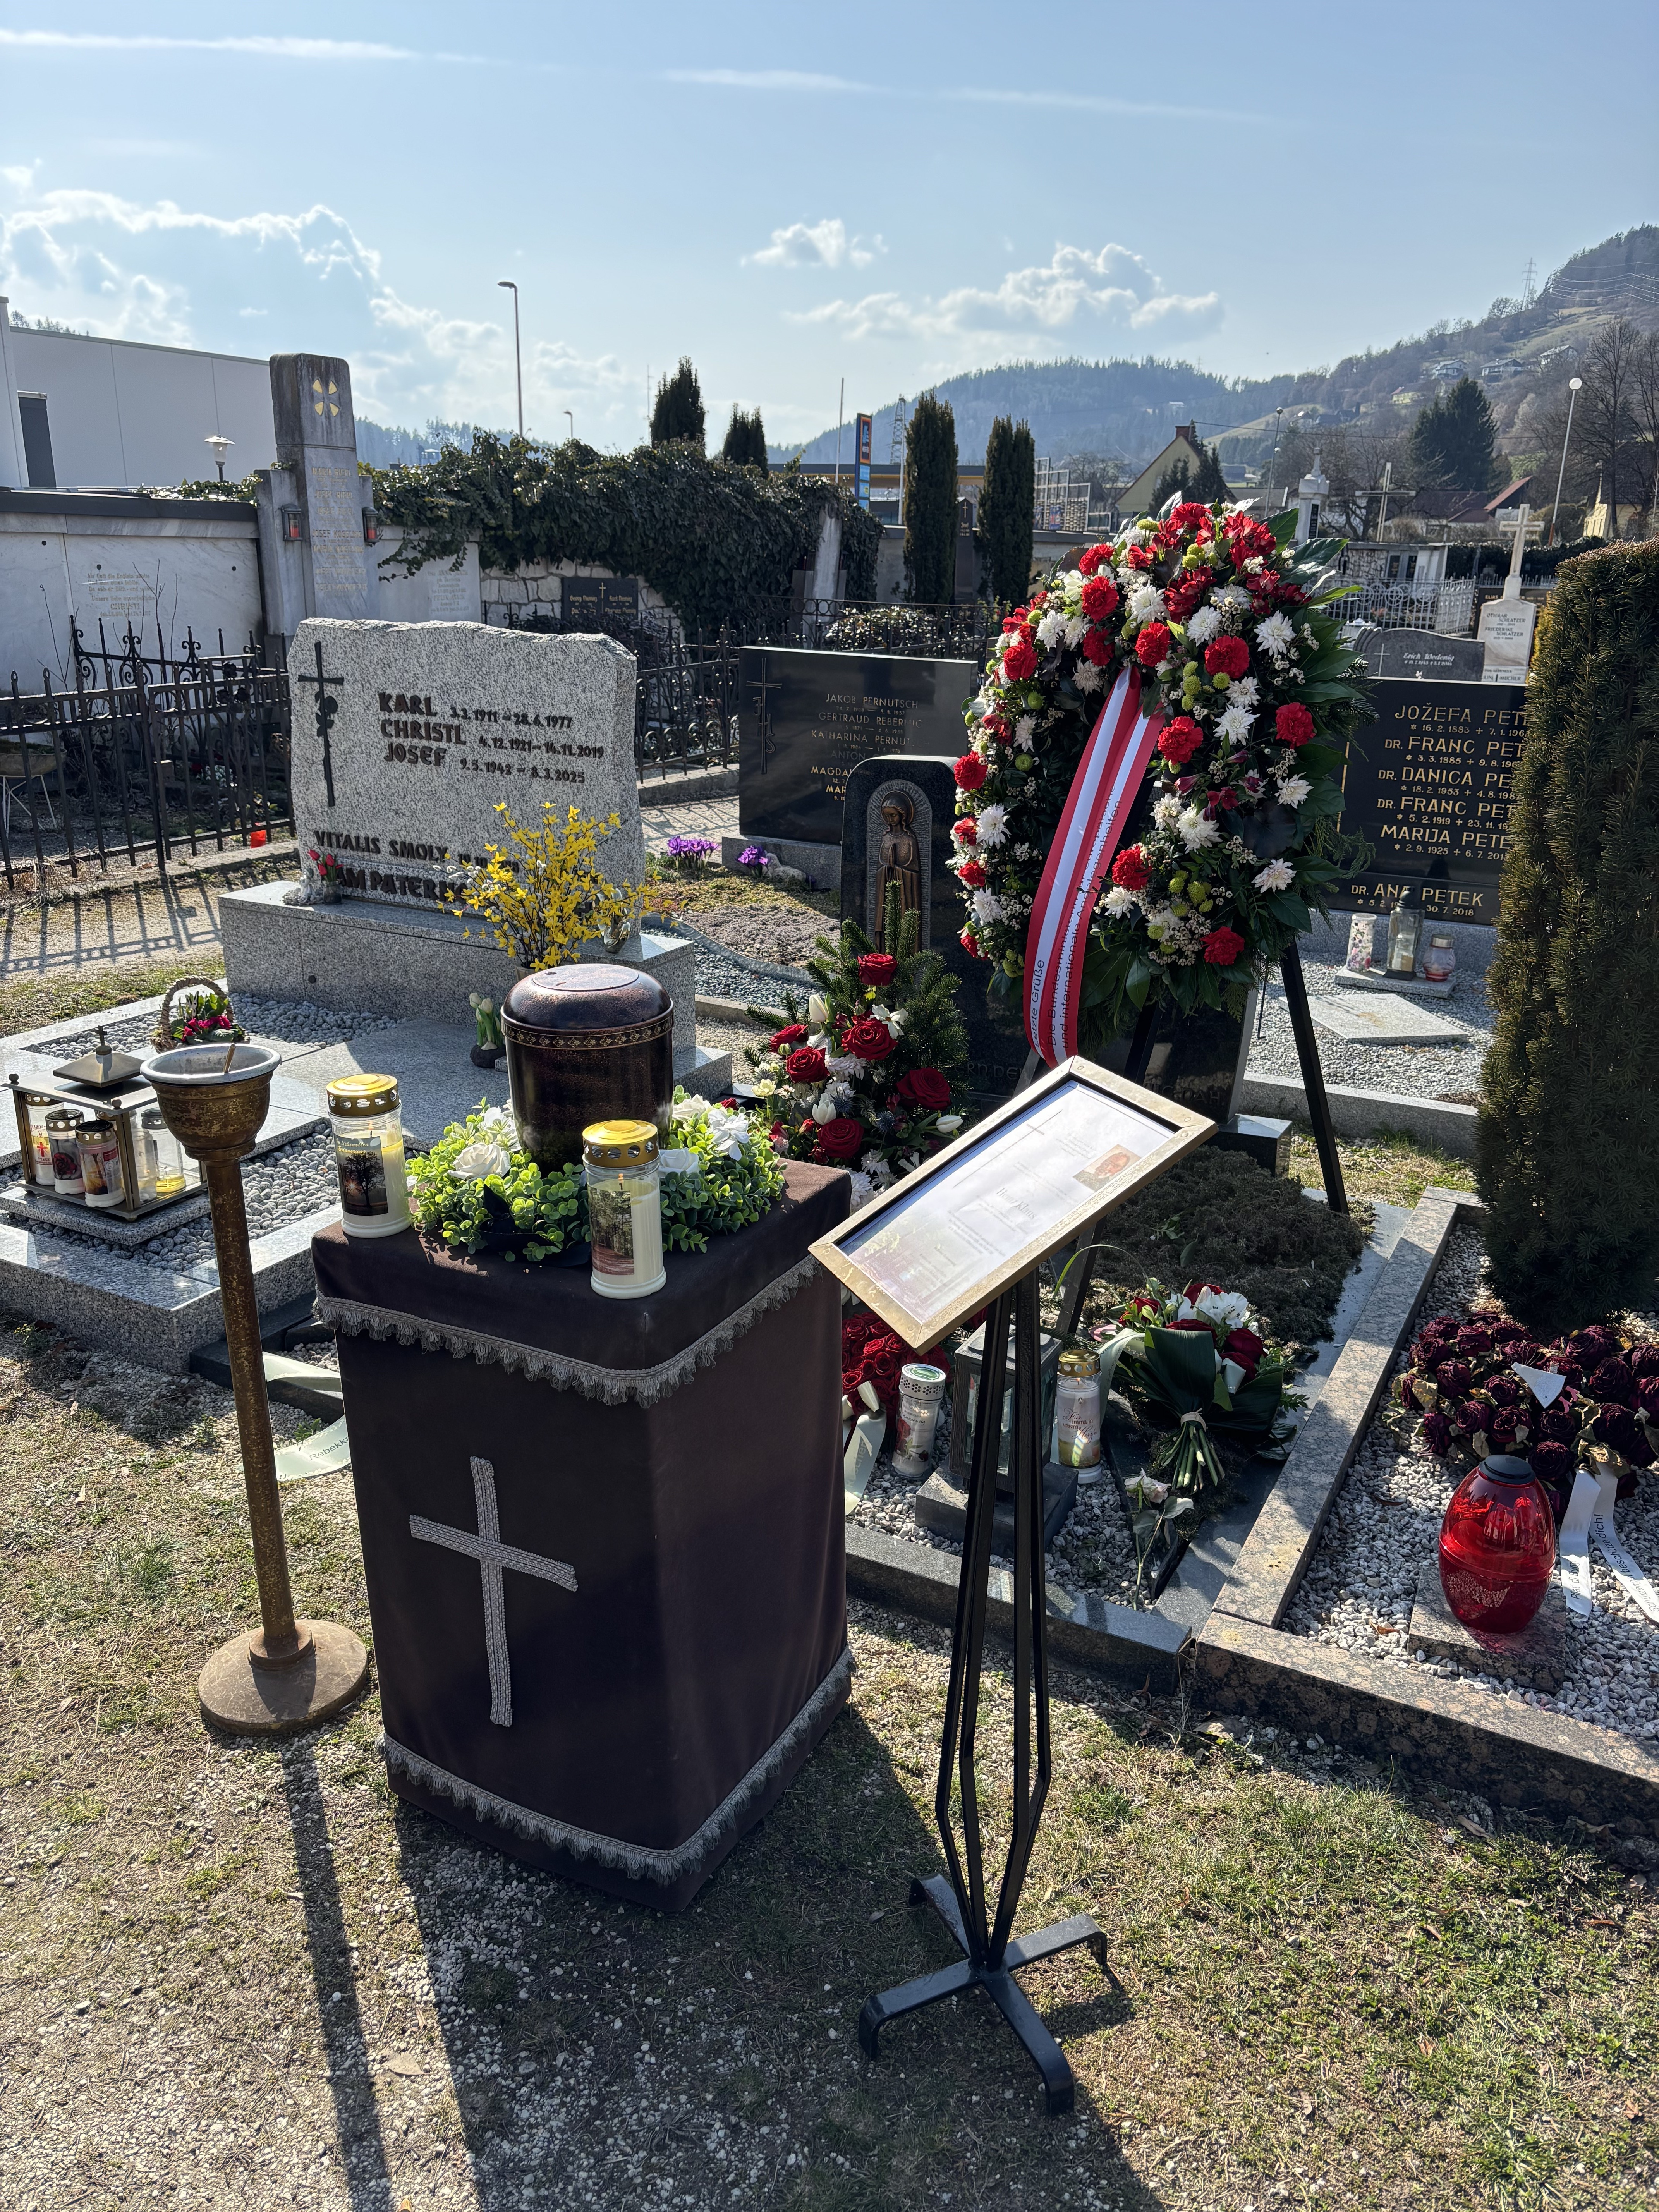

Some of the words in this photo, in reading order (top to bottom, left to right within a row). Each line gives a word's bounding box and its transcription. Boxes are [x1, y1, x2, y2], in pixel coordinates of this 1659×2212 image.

[378, 692, 437, 716] KARL
[826, 694, 856, 704] JAKOB
[863, 697, 918, 709] PERNUTSCH
[819, 712, 869, 723] GERTRAUD
[1395, 702, 1472, 722] JOŽEFA
[1483, 710, 1529, 726] PETE
[380, 719, 466, 745] CHRISTL
[811, 730, 868, 743] KATHARINA
[384, 742, 447, 767] JOSEF
[831, 750, 866, 761] ANTON
[1384, 739, 1403, 749] DR.
[1408, 736, 1475, 754] FRANC
[1486, 741, 1524, 757] PET
[811, 766, 852, 777] MAGDA
[1378, 770, 1396, 780] DR.
[1402, 767, 1472, 785] DANICA
[1484, 773, 1511, 788] PE
[826, 785, 846, 793] MAR
[1377, 799, 1396, 809] DR.
[1400, 797, 1467, 815] FRANC
[1477, 803, 1515, 818] PET
[1085, 785, 1116, 870] europäische
[1468, 820, 1482, 828] 23.
[314, 830, 381, 854] VITALIS
[389, 839, 448, 862] SMOLY
[1380, 825, 1451, 843] MARIJA
[1462, 832, 1511, 849] PETE
[1077, 800, 1122, 920] Angelegenheiten
[1428, 846, 1448, 855] 1925
[370, 871, 471, 905] PATERNO
[1351, 885, 1369, 895] DR.
[1422, 888, 1484, 907] PETEK
[1453, 908, 1474, 916] 2018
[1048, 898, 1078, 1018] Bundesministerin
[1032, 960, 1044, 1003] Grüße
[1060, 924, 1080, 1018] internationale
[1048, 1024, 1056, 1046] Die
[1060, 1024, 1069, 1048] und
[1063, 1407, 1082, 1421] Für
[1594, 1514, 1607, 1538] dich!
[1603, 1539, 1631, 1573] beschütze
